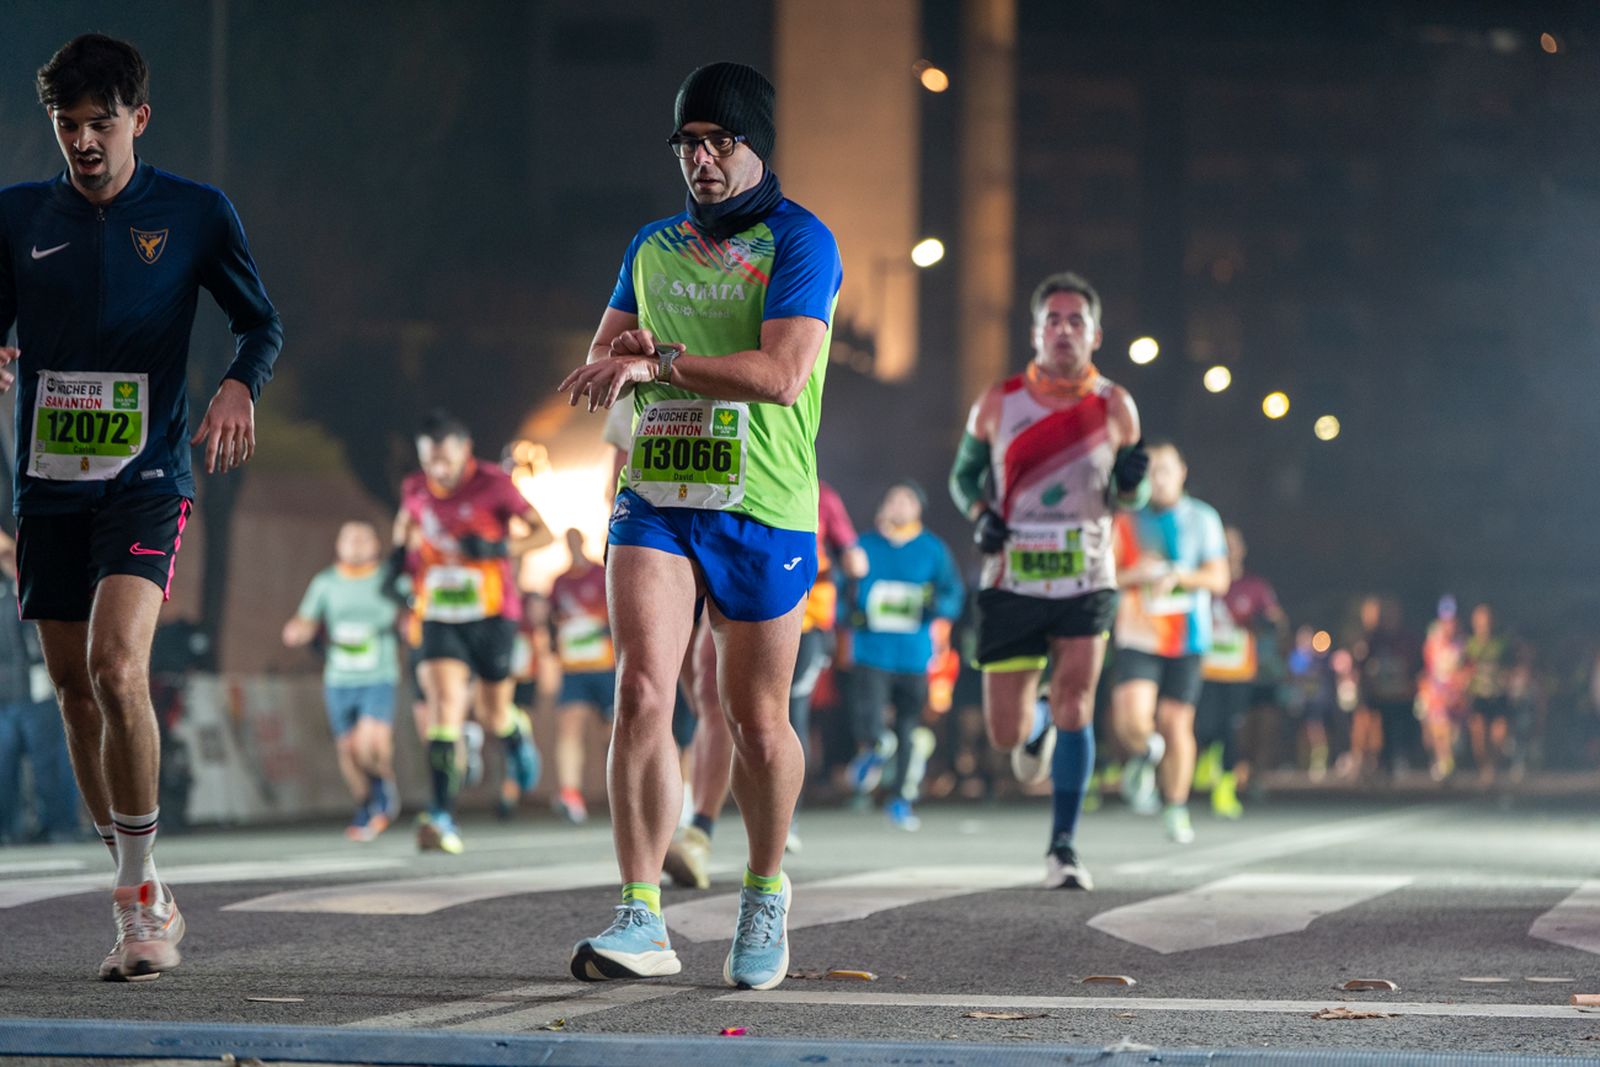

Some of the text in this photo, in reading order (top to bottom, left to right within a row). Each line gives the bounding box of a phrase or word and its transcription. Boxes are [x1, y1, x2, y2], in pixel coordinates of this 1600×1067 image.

[89, 385, 103, 395] DE
[45, 394, 102, 409] SAN ANTÓN
[657, 411, 703, 422] NOCHE DE
[47, 411, 129, 444] 12072
[643, 422, 702, 436] SAN ANTÓN
[641, 438, 732, 472] 13066
[673, 472, 694, 481] David
